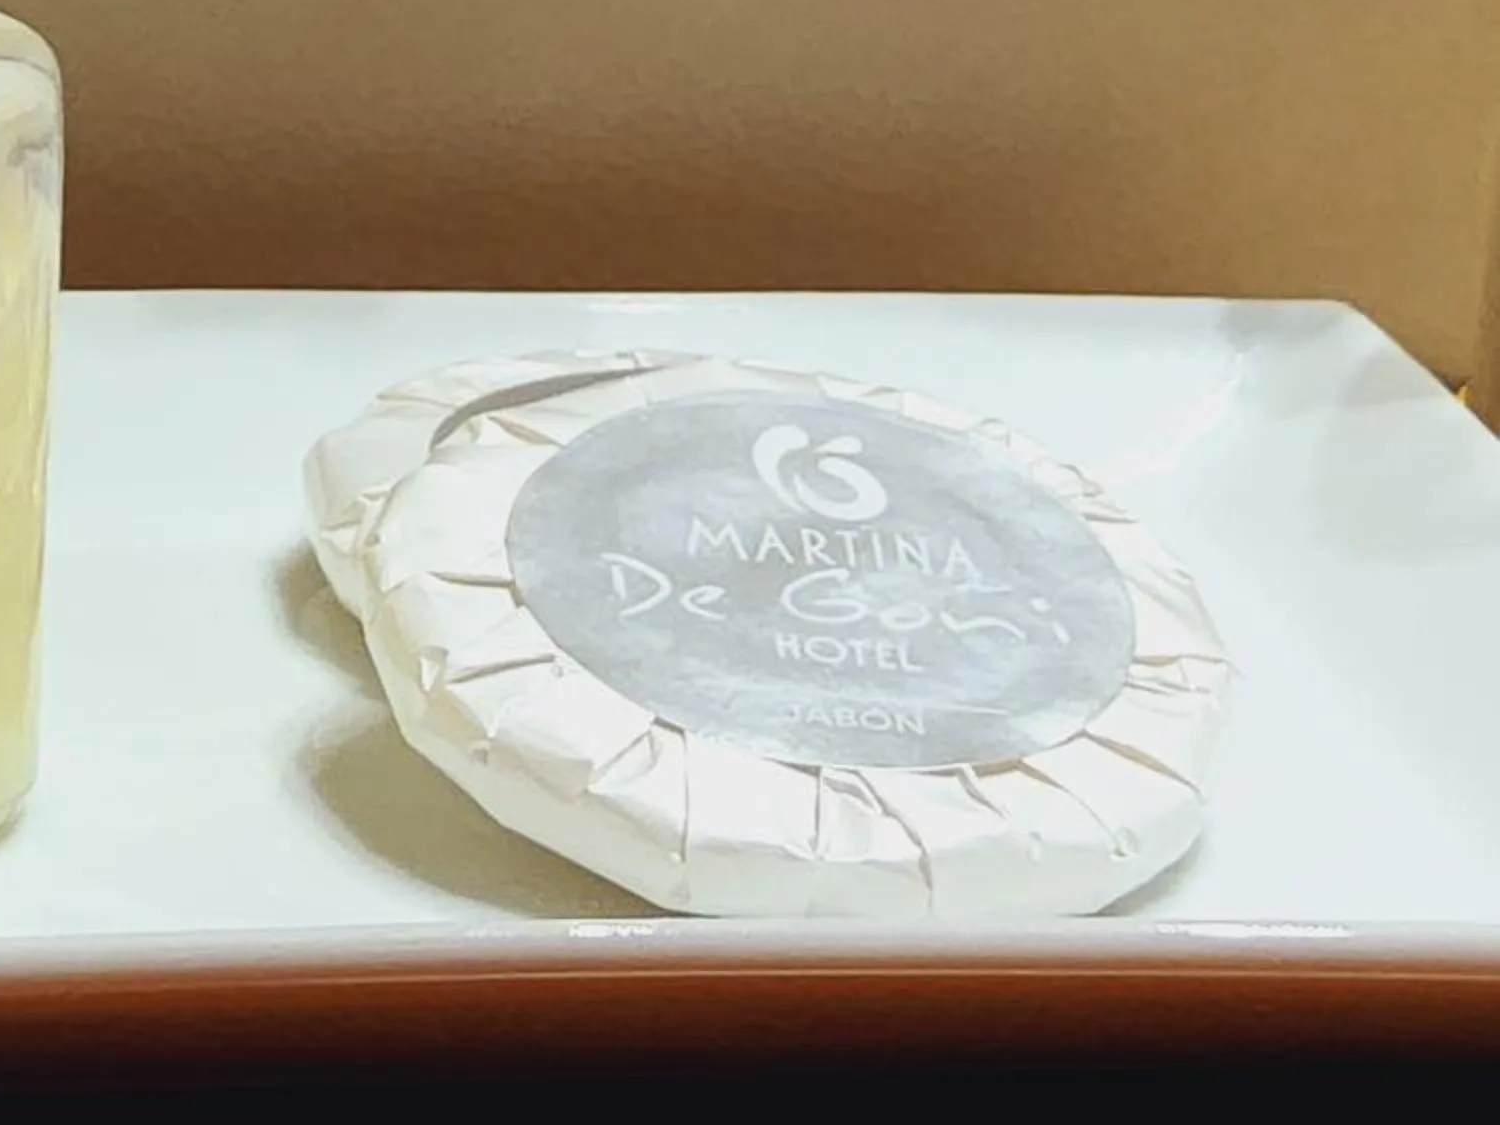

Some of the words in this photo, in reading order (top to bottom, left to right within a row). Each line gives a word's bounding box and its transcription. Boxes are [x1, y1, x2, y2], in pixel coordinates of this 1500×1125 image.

[687, 518, 982, 577] MARTINA
[601, 551, 728, 622] De
[778, 633, 924, 672] HOTEL
